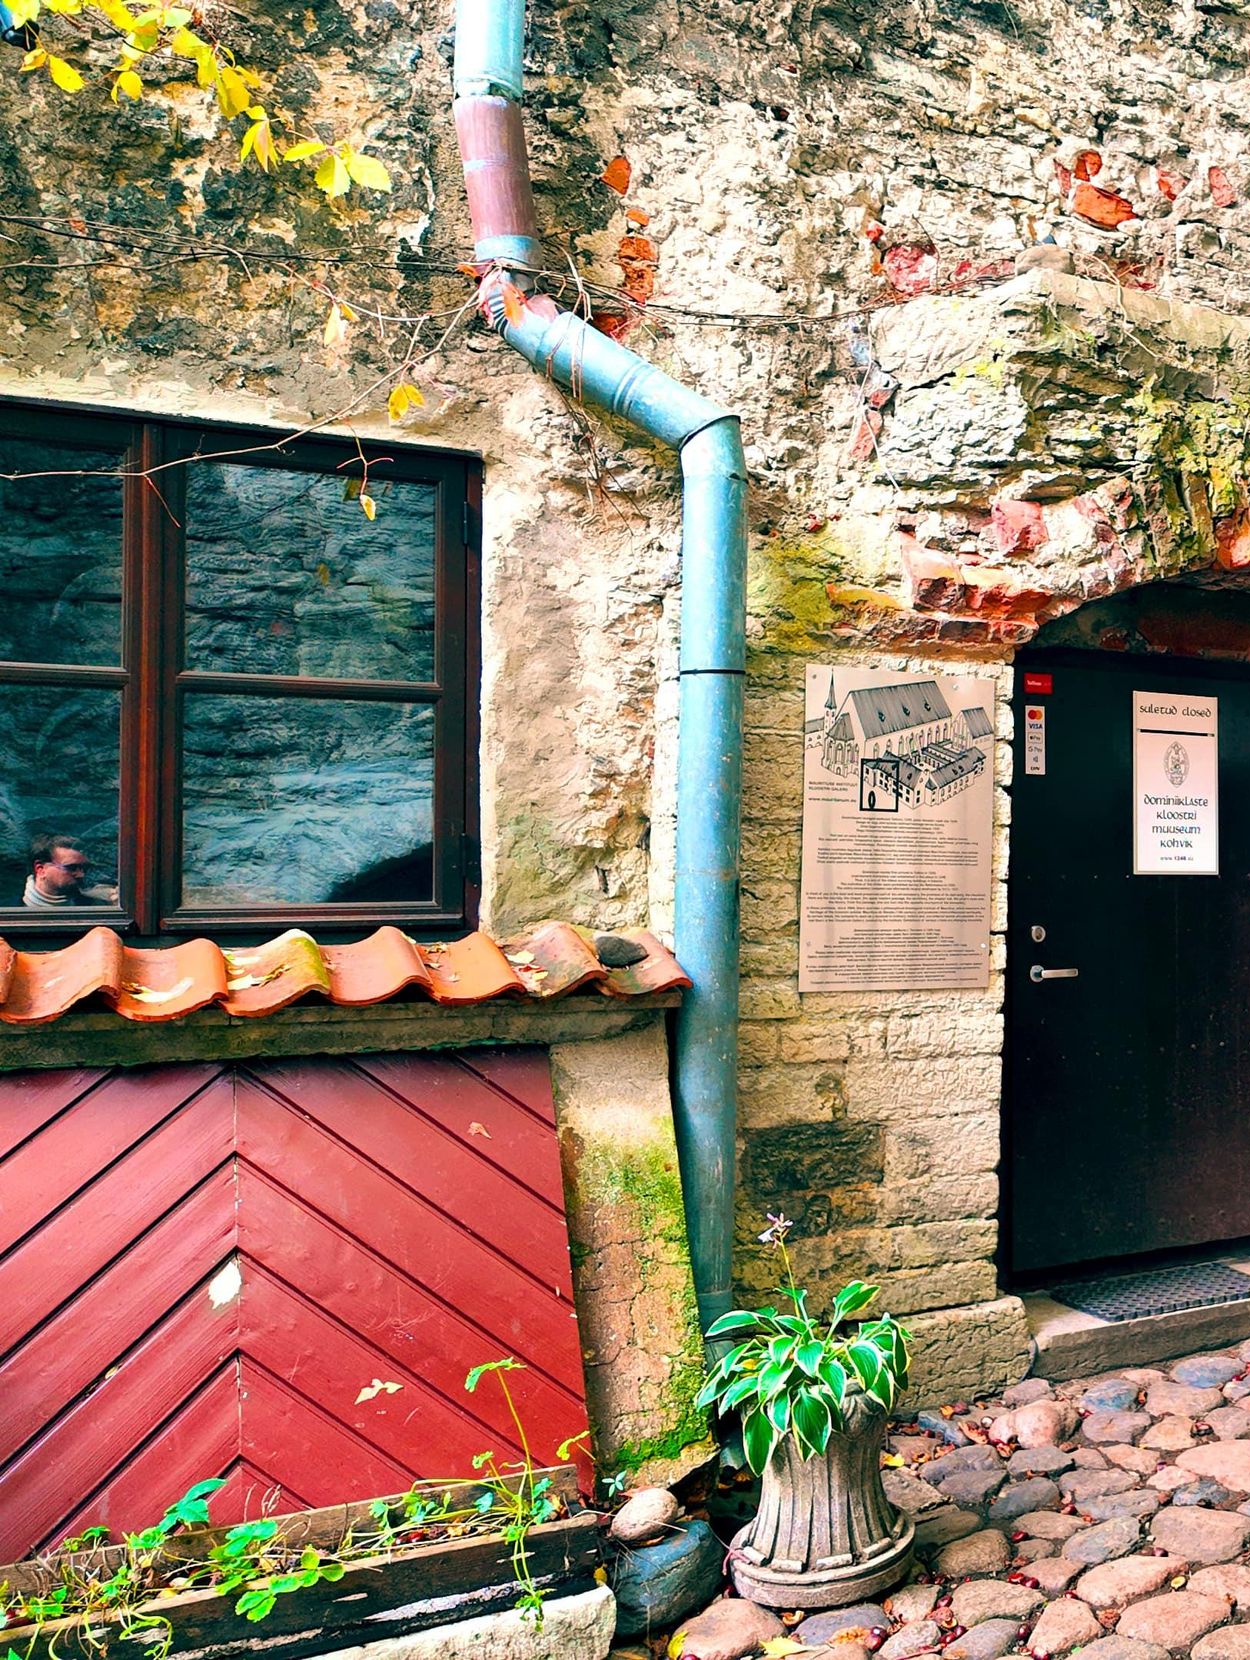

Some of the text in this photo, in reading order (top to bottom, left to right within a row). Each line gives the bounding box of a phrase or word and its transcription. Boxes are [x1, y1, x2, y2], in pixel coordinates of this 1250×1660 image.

[1139, 704, 1212, 718] suletud closed
[1143, 794, 1209, 808] dominiiklaste
[1156, 810, 1197, 821] kloostri
[1152, 824, 1201, 835] muuseum
[1160, 838, 1193, 849] kohvik
